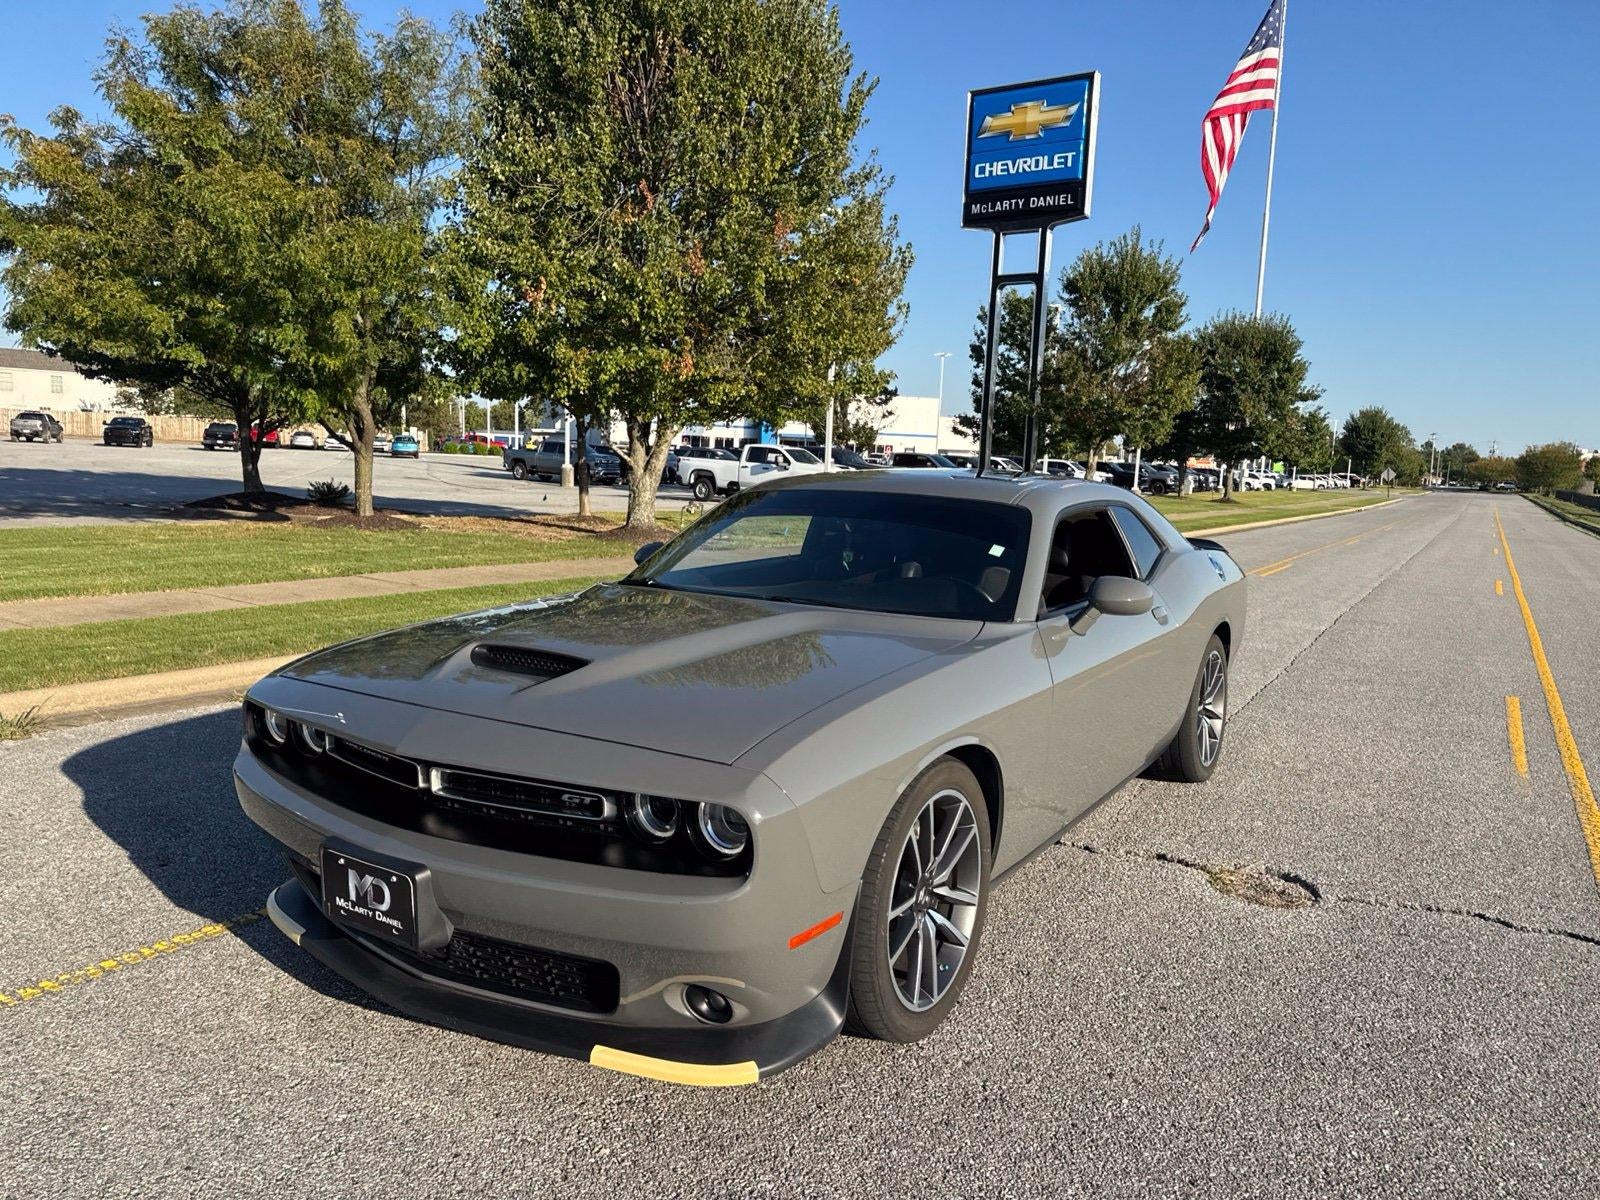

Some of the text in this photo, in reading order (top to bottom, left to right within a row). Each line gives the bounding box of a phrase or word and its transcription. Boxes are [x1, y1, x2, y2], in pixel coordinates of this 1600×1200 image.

[974, 152, 1076, 178] CHEVROLET
[971, 194, 1075, 214] McLARTY DANIEL
[560, 793, 599, 807] GT
[348, 868, 391, 911] MD
[375, 911, 404, 929] DANIEL
